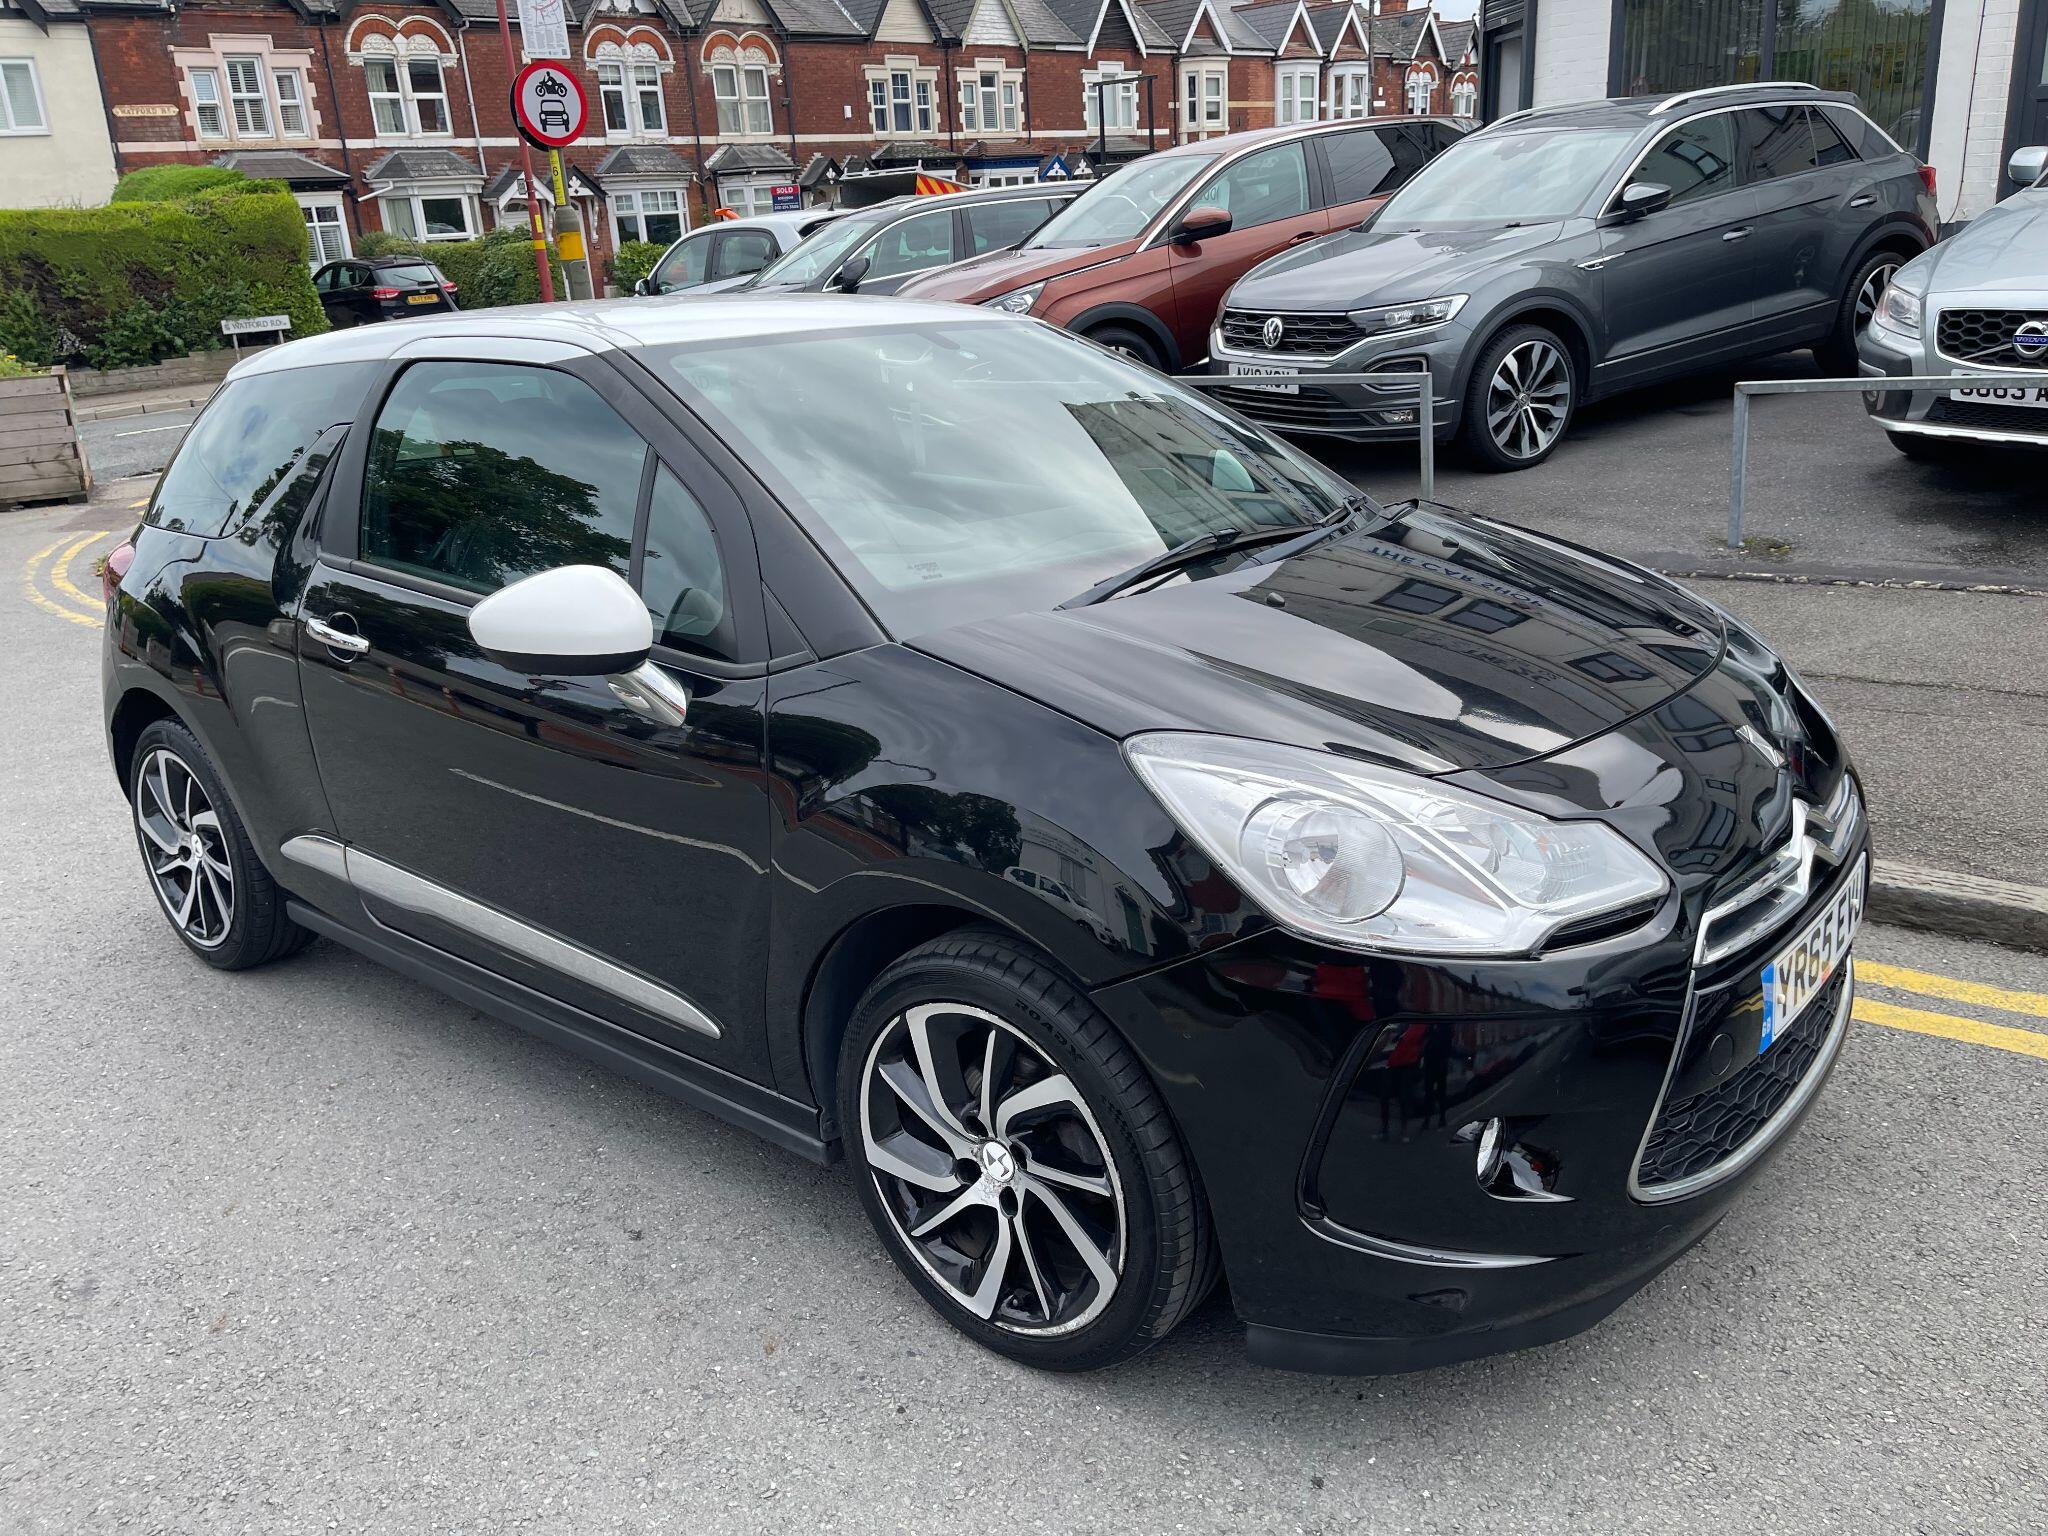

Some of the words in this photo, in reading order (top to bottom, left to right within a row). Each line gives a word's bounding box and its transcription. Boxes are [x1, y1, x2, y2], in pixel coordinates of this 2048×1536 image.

[776, 186, 794, 194] SOLD
[232, 320, 268, 330] WATFORD
[270, 319, 282, 328] RD
[1779, 910, 1833, 1019] YR65
[1015, 999, 1086, 1062] ROADX
